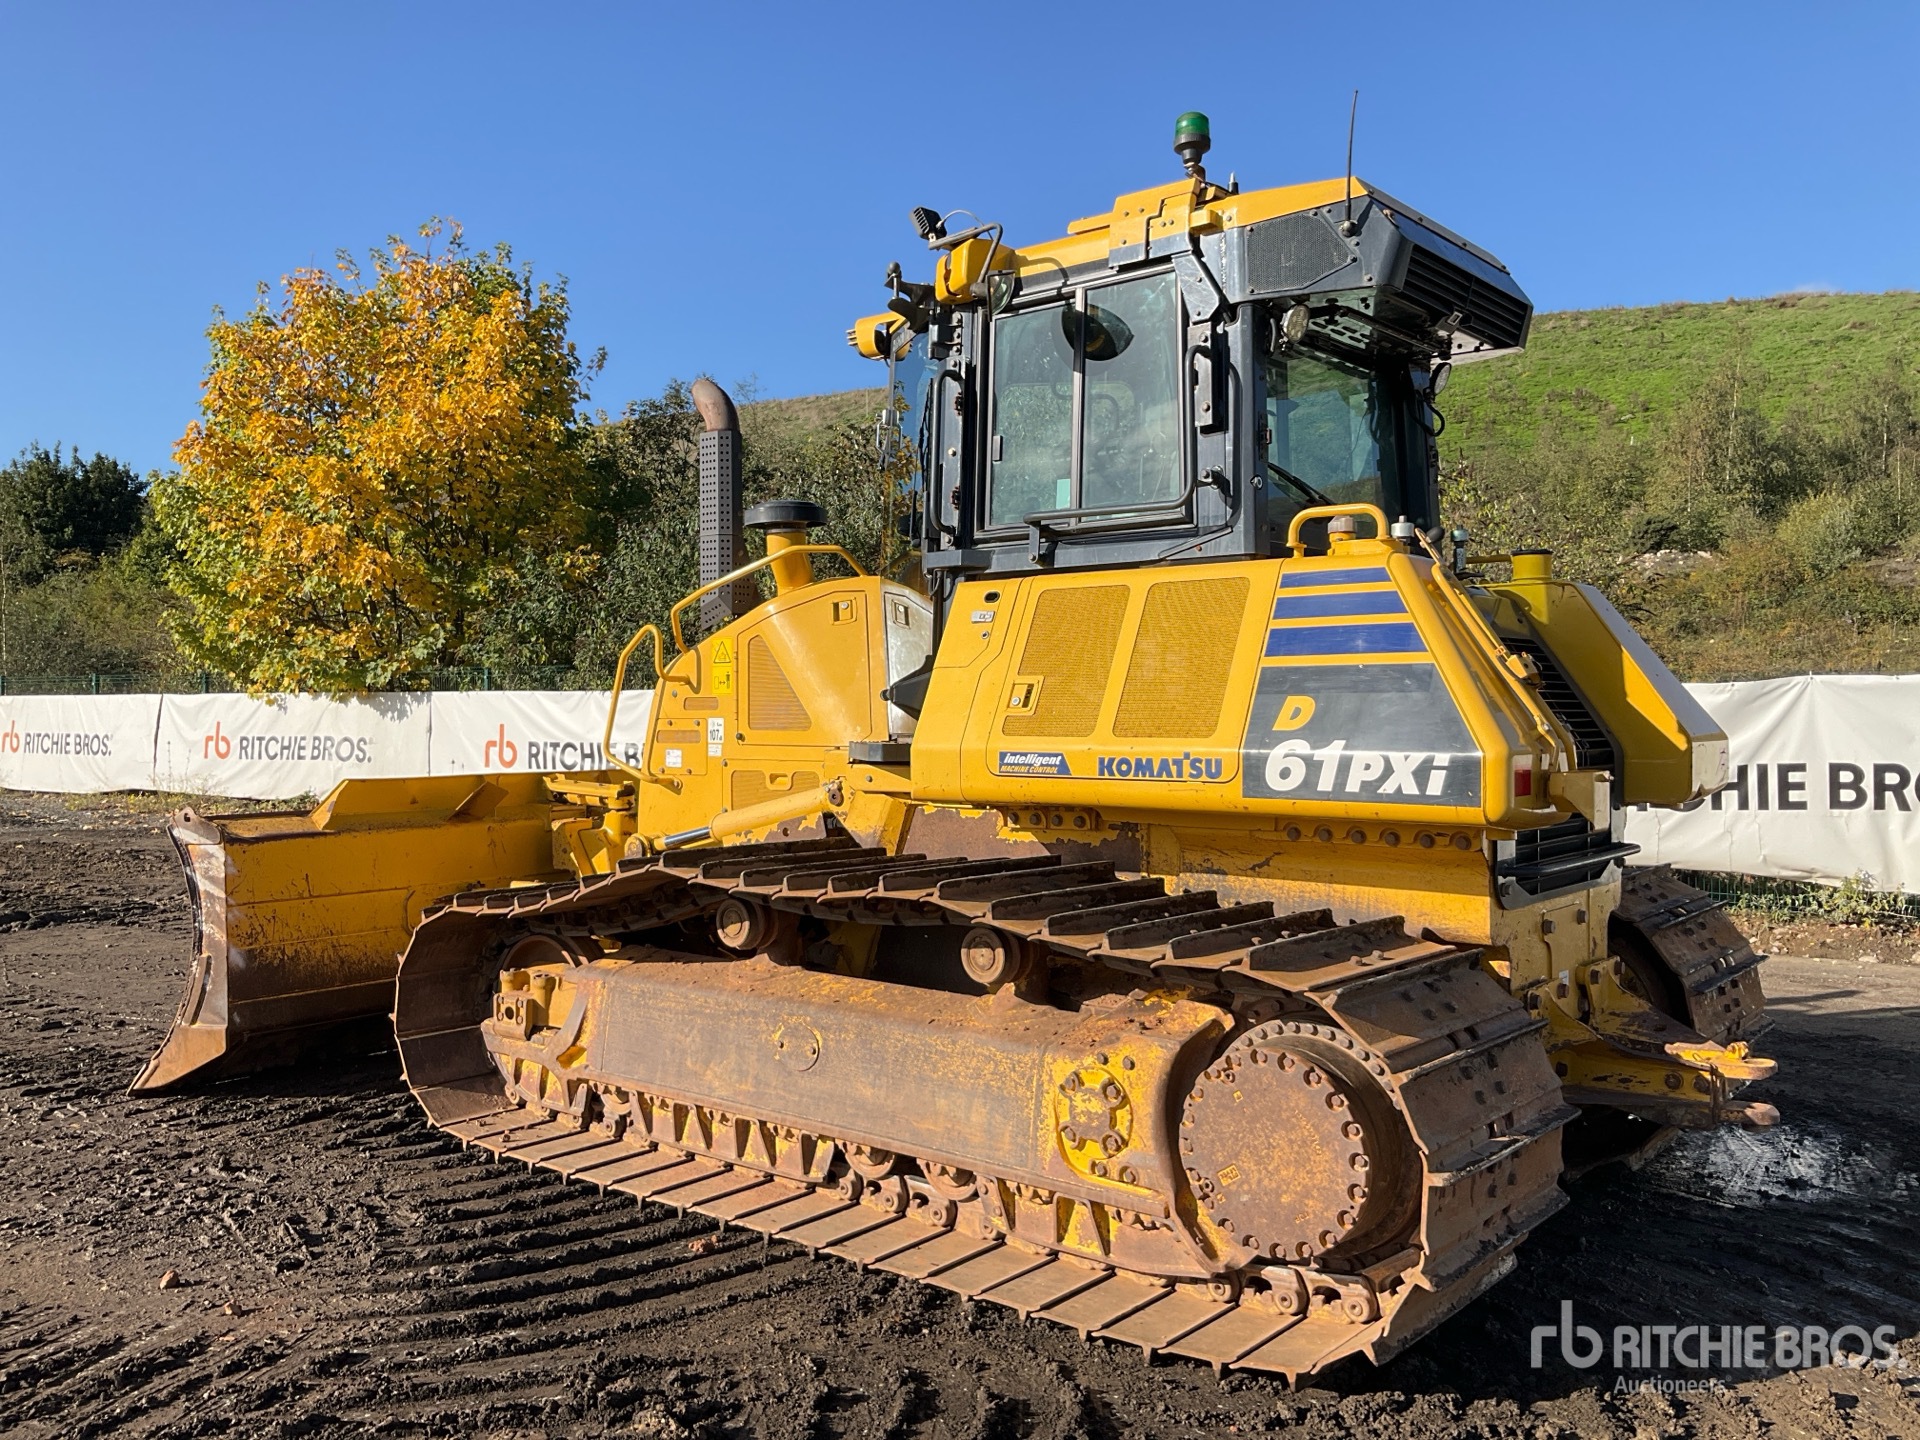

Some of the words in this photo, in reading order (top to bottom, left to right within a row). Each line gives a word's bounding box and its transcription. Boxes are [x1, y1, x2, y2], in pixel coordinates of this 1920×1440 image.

[1272, 695, 1316, 731] D
[24, 733, 71, 754] RITCHIE
[239, 735, 306, 760] RITCHIE
[484, 723, 518, 768] rb
[624, 742, 645, 769] B
[1000, 765, 1029, 773] MACHINE
[1029, 766, 1058, 774] CONTROL
[1003, 753, 1062, 766] intelligent
[1097, 752, 1223, 779] KOMATSU
[1265, 739, 1451, 796] 61PXi
[1828, 762, 1920, 811] BR
